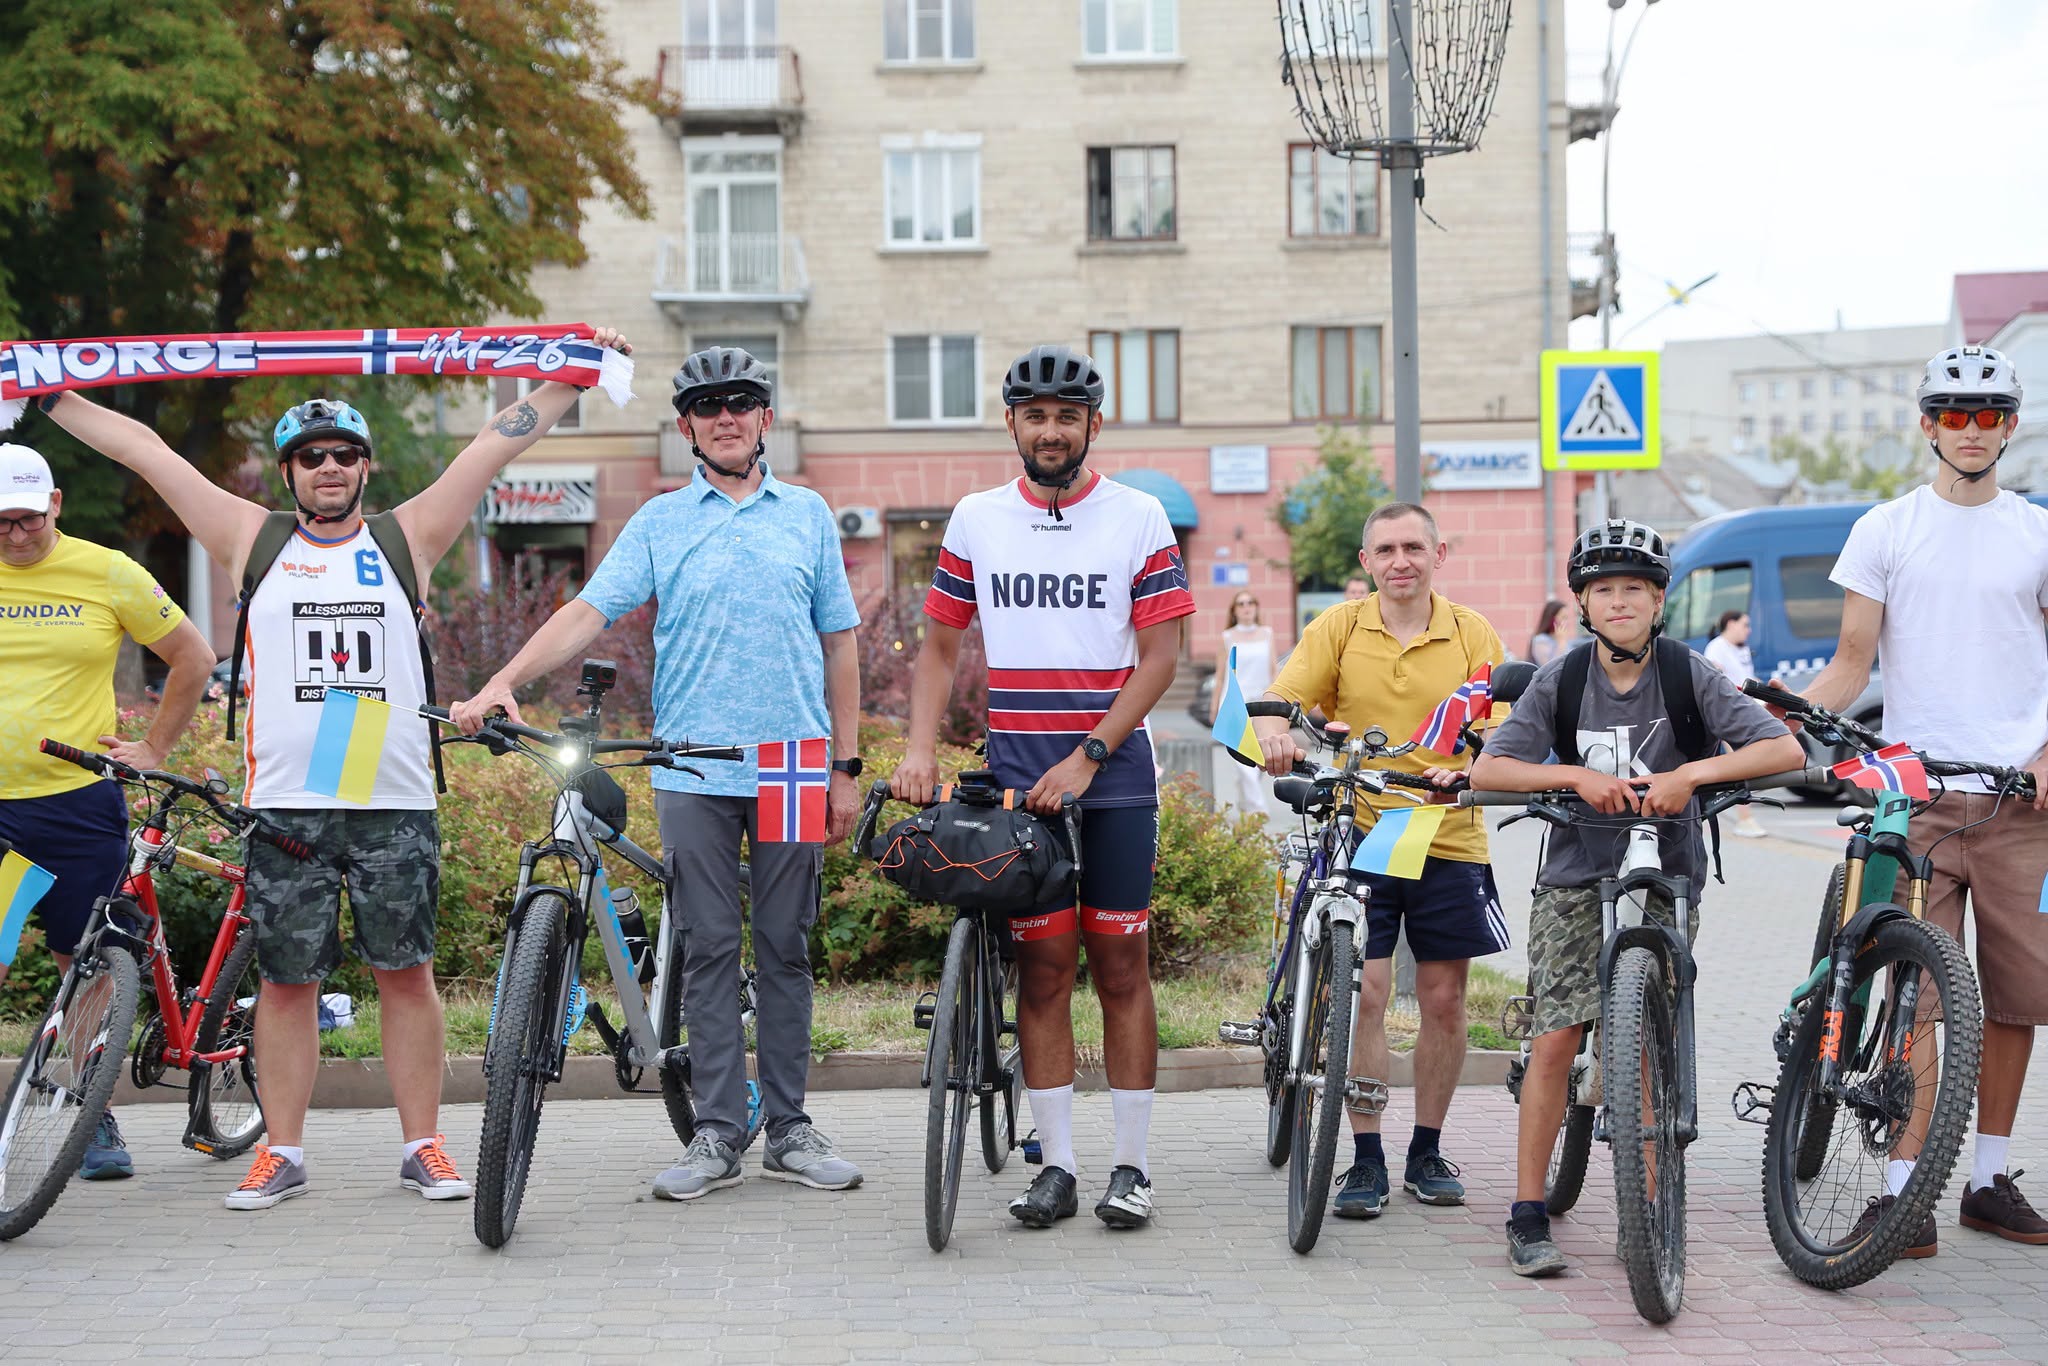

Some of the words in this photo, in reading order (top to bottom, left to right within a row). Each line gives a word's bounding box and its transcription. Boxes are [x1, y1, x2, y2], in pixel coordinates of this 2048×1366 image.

[12, 340, 258, 389] NORGE
[1040, 523, 1072, 531] hummel
[354, 549, 384, 586] 6
[991, 572, 1108, 609] NORGE
[299, 604, 381, 616] ALESSANDRO
[300, 688, 384, 700] DISTUZIONI
[1095, 911, 1139, 922] Santini
[1012, 917, 1049, 929] Santini
[1818, 1010, 1844, 1062] FOX
